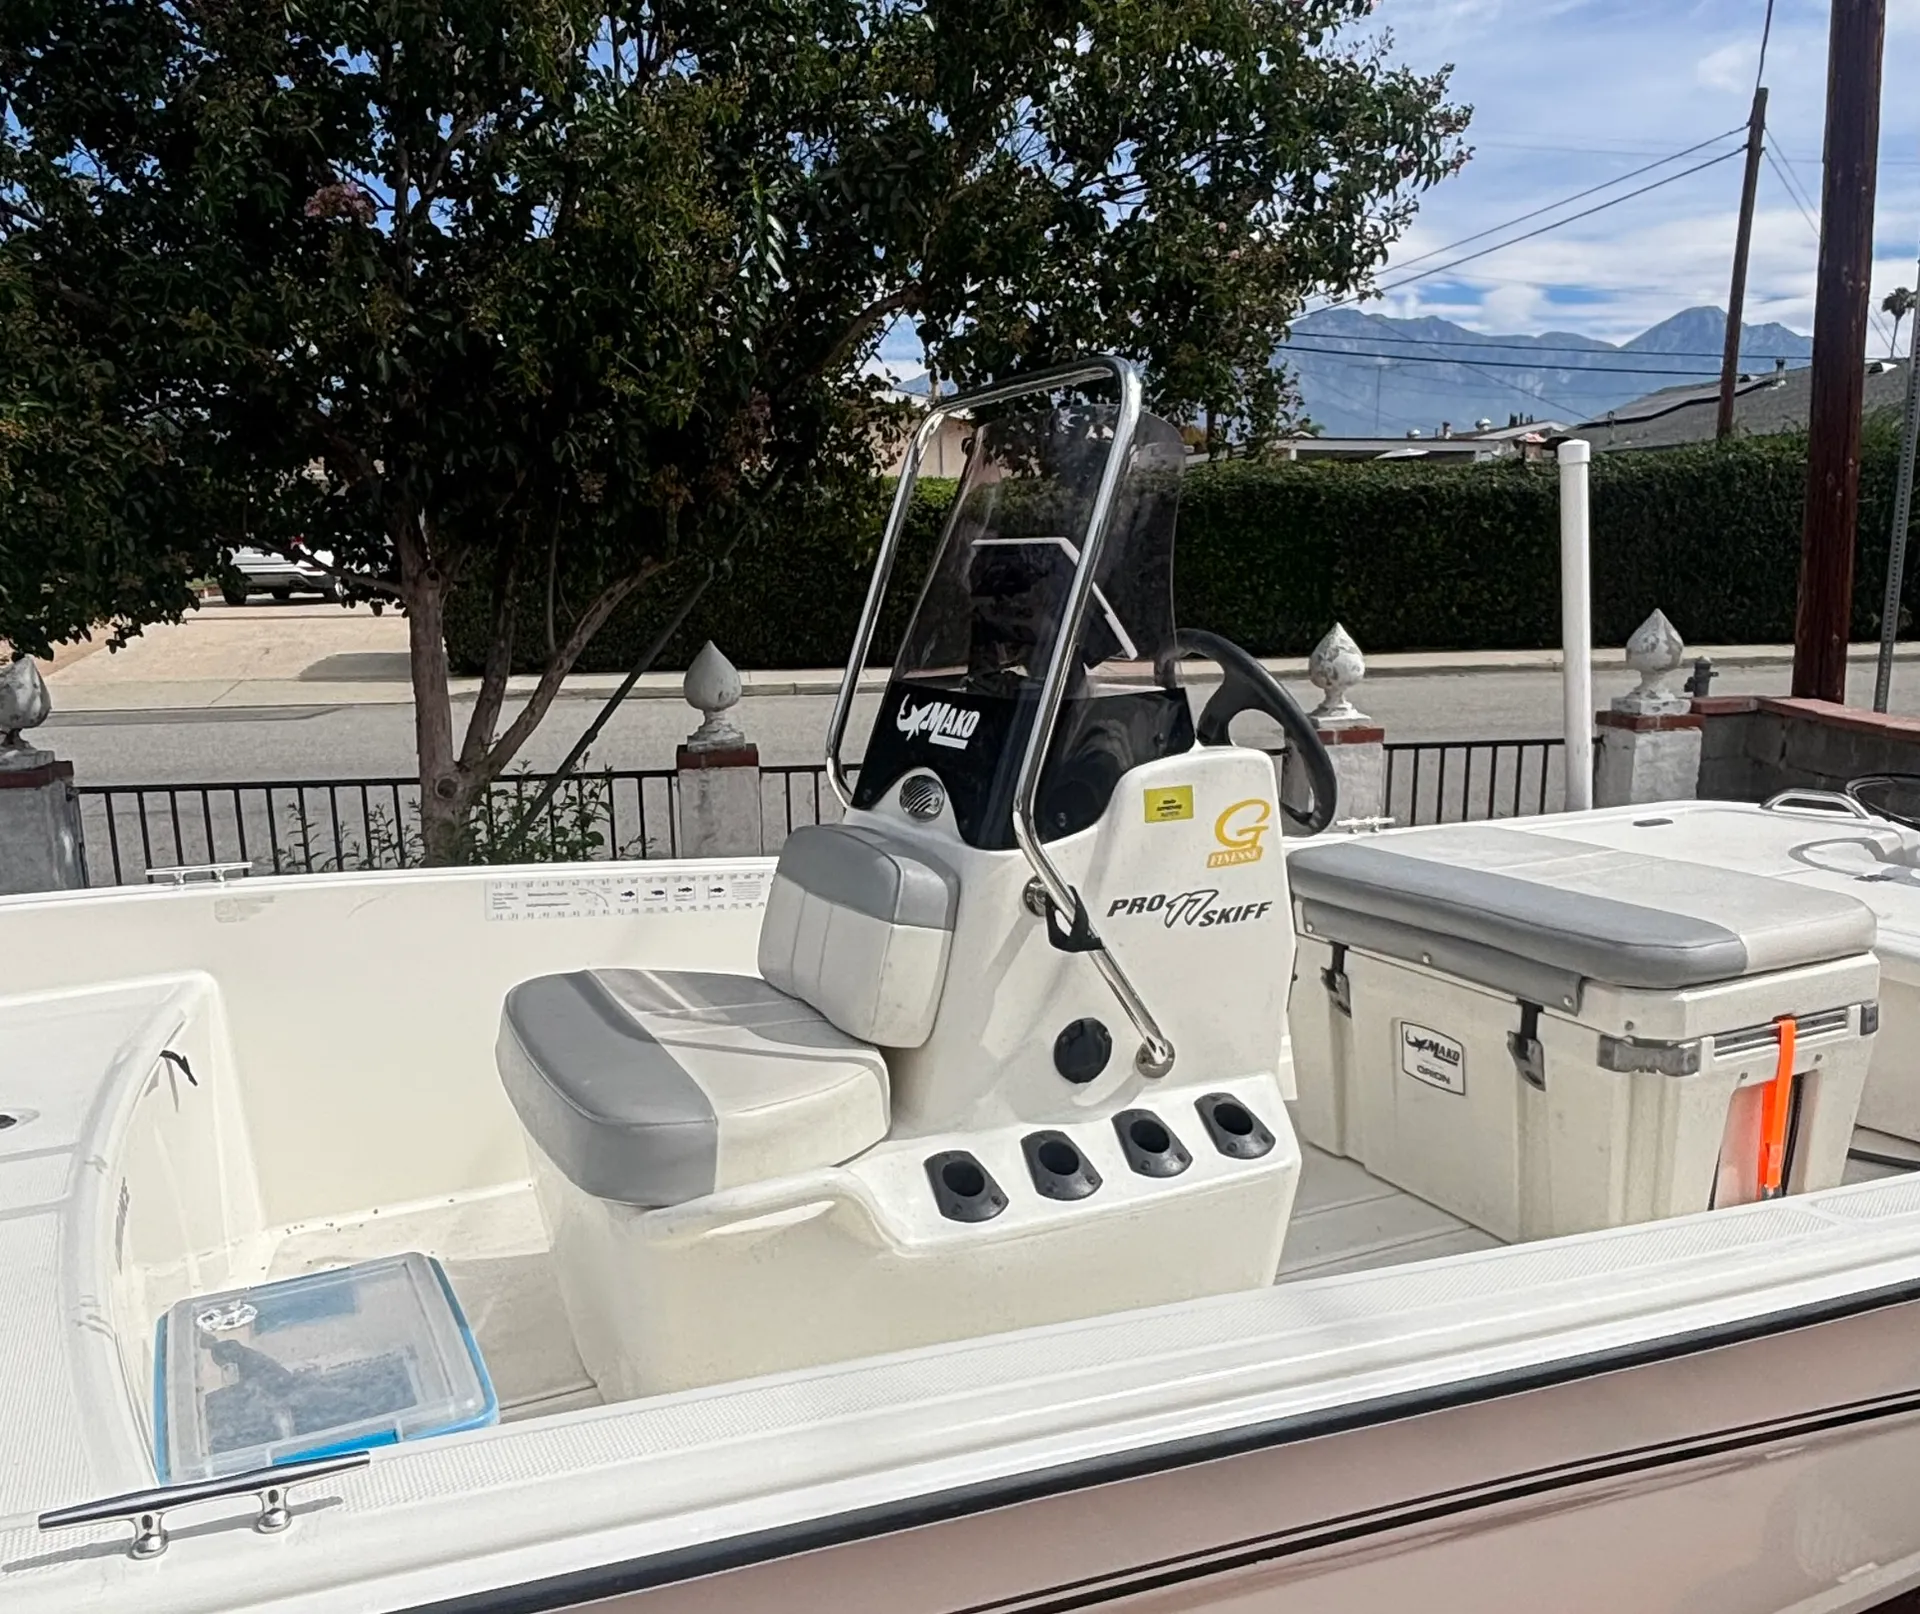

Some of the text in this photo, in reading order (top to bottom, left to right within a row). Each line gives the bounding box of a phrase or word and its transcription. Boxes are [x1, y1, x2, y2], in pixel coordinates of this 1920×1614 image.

[921, 701, 980, 750] MAKO
[1106, 894, 1166, 917] PRO
[1198, 901, 1273, 927] SKIFF
[1424, 1040, 1460, 1067] MAKO
